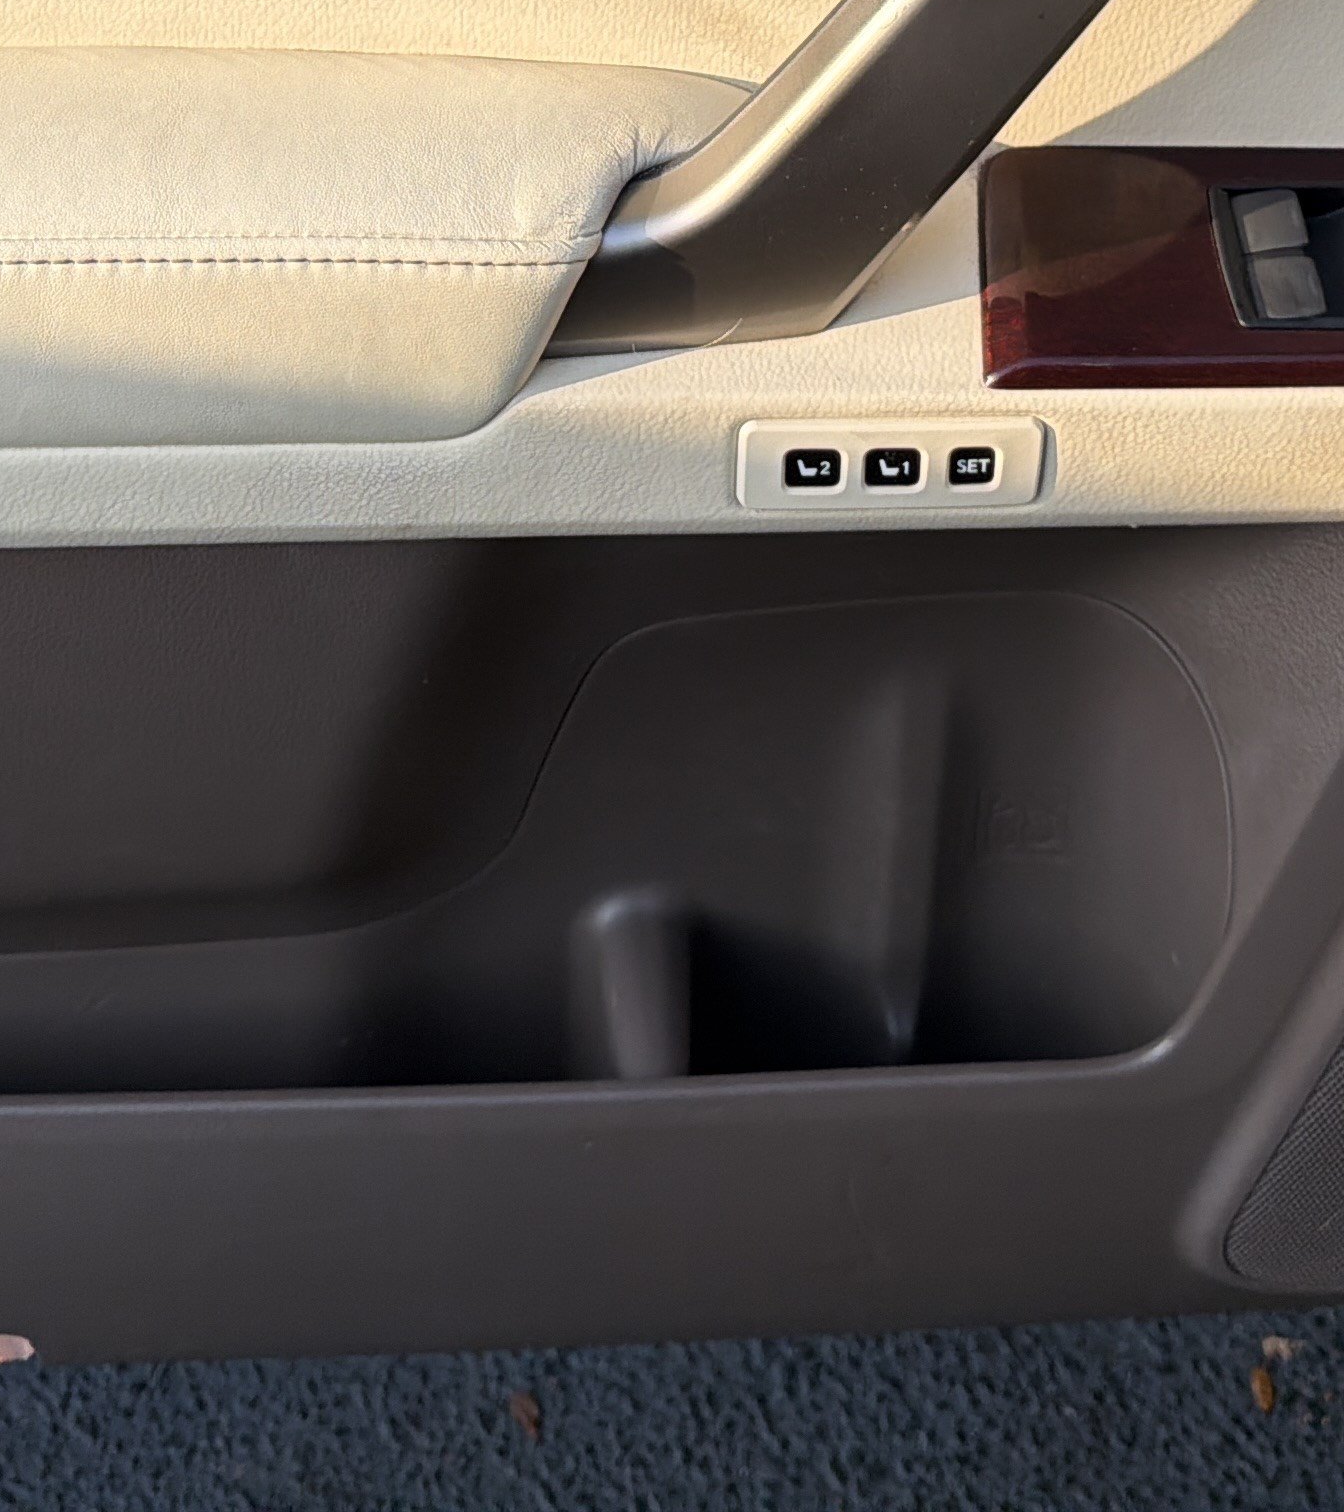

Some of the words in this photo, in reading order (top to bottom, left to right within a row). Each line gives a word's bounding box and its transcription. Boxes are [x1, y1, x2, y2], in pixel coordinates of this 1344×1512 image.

[819, 460, 831, 476] 2
[902, 460, 910, 475] 1
[956, 458, 991, 474] SET
